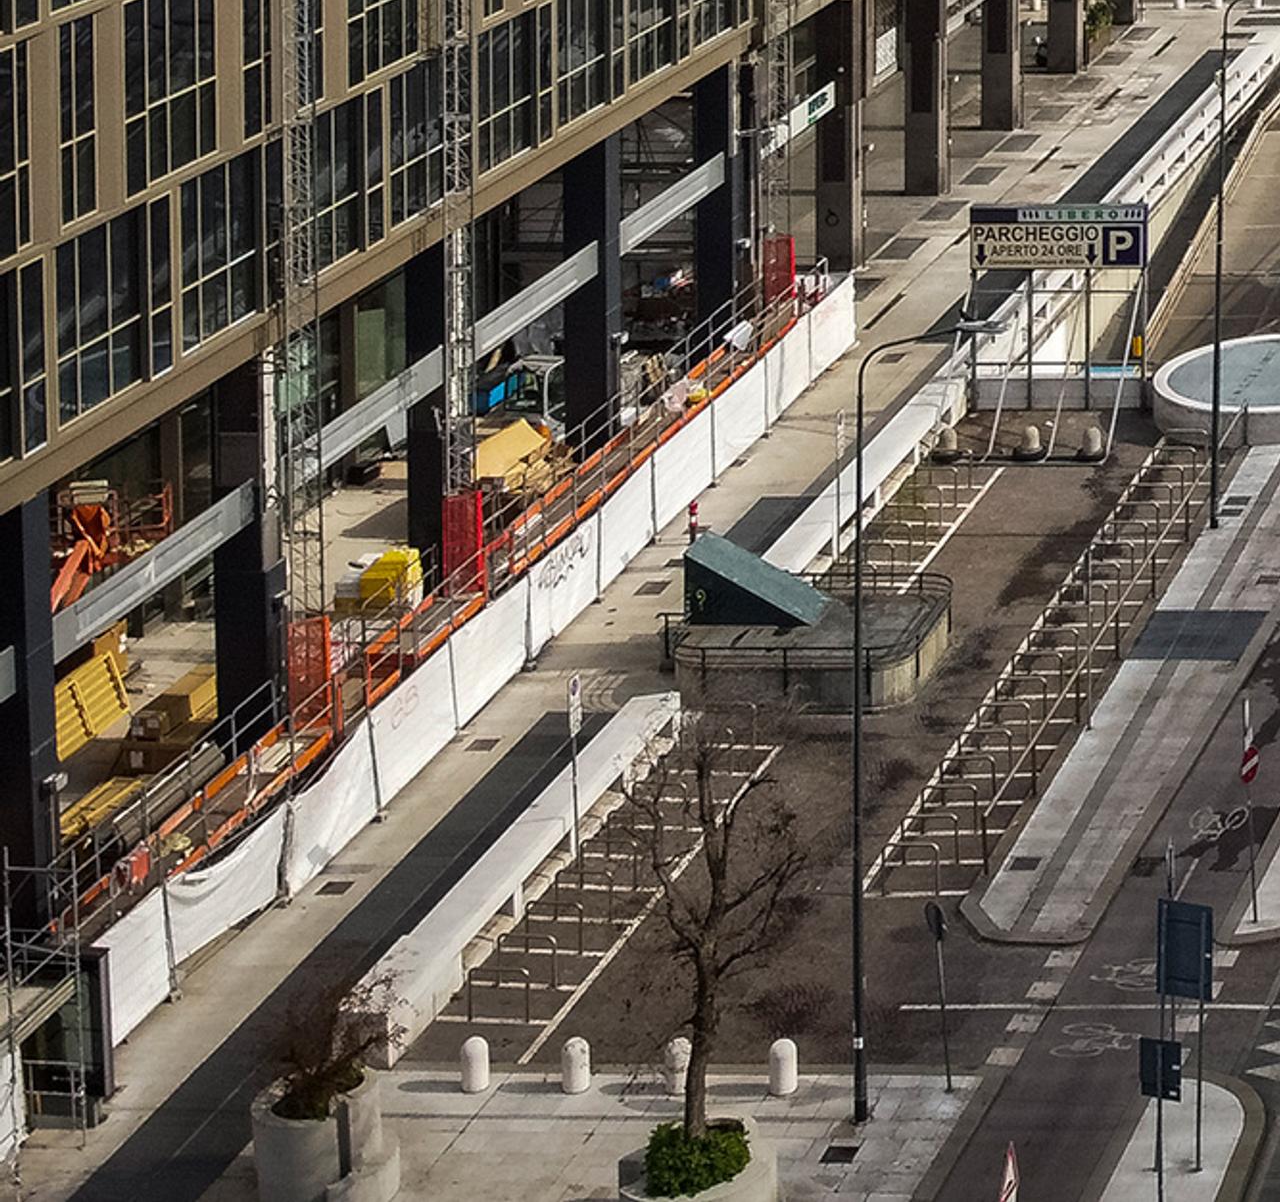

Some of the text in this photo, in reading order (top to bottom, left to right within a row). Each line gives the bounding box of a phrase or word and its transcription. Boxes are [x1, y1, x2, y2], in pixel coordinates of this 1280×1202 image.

[1044, 209, 1120, 221] LIBERO
[973, 225, 1100, 242] PARCHEGGIO
[990, 244, 1083, 257] APERTO 24 ORE
[1108, 229, 1134, 262] P
